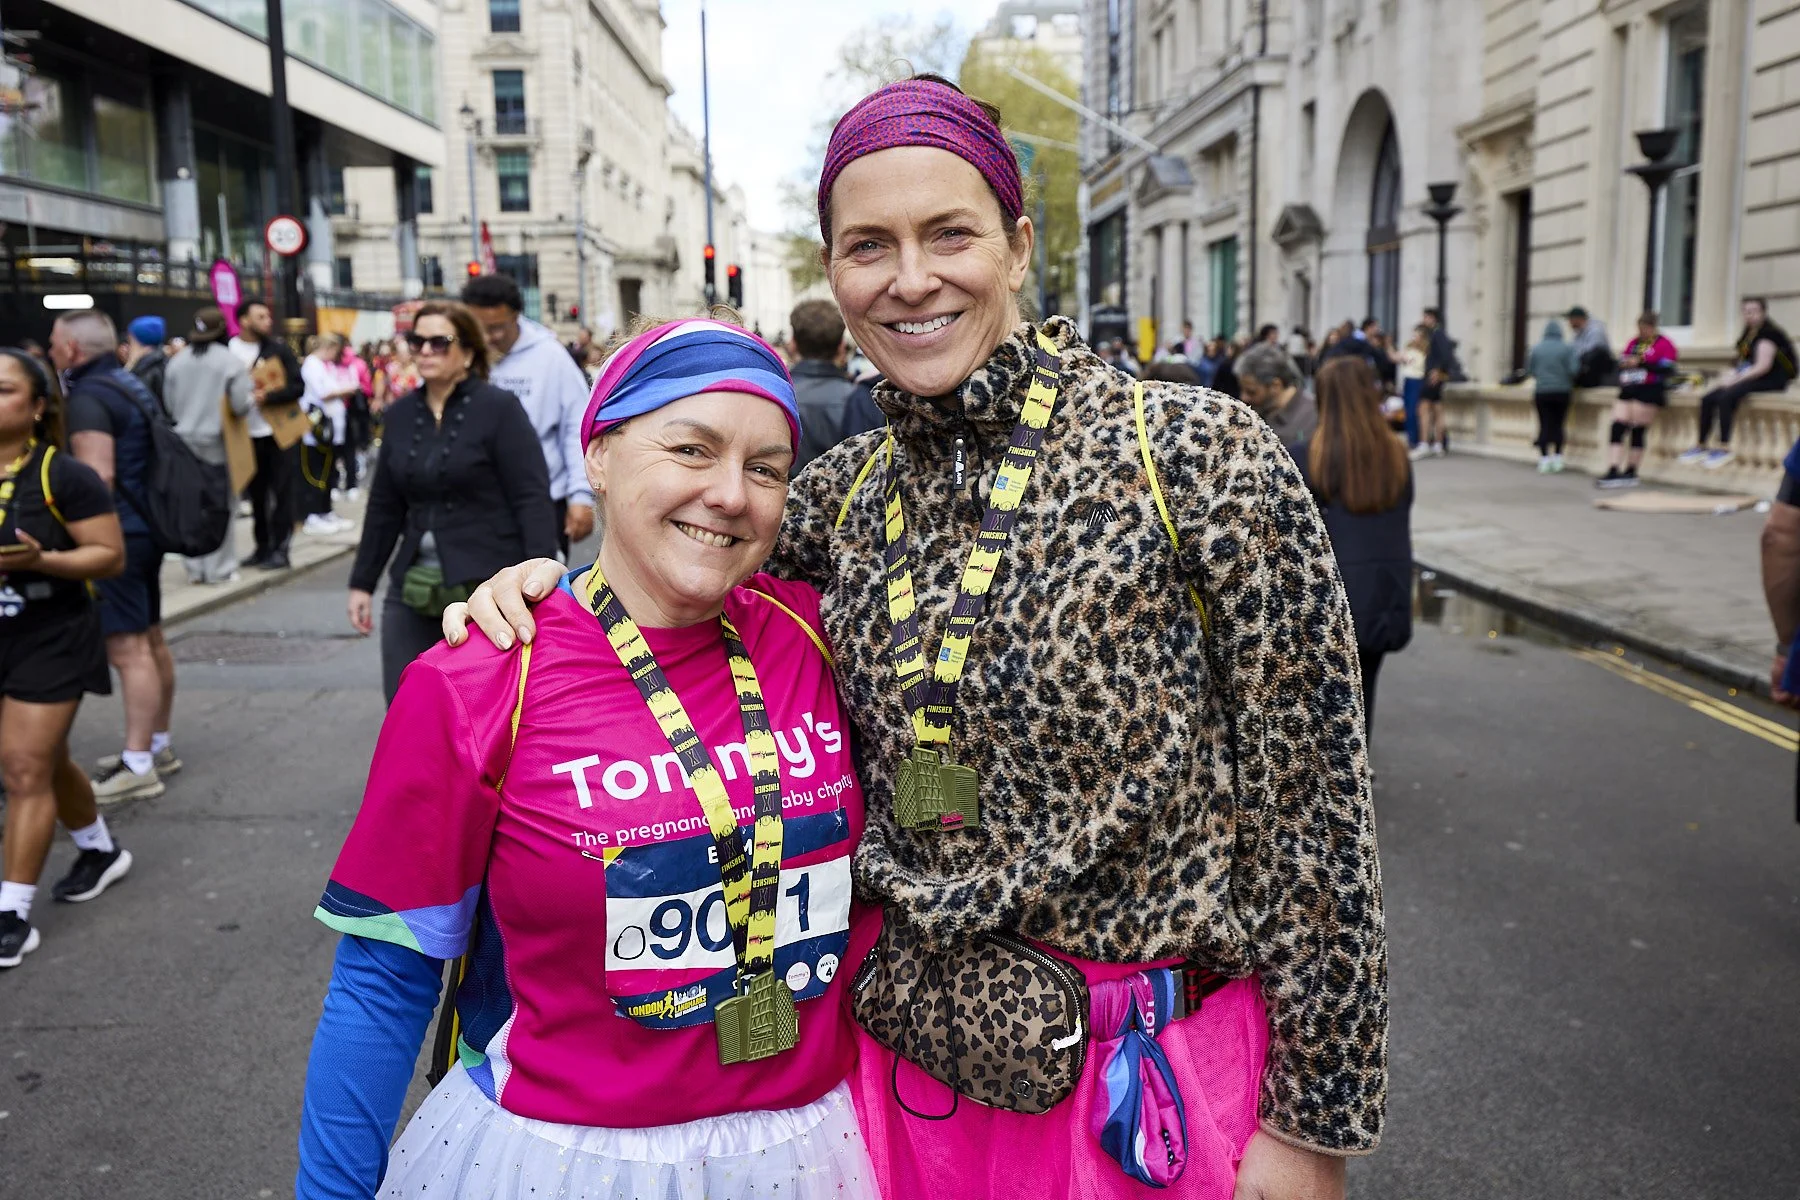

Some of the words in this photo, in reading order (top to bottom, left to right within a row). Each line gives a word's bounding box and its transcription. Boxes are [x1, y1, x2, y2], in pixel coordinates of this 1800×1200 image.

[1036, 365, 1059, 380] FINISHER
[1008, 445, 1036, 458] FINISHER
[979, 530, 1007, 541] FINISHER
[888, 553, 908, 574] FINISHER
[950, 616, 976, 625] FINISHER
[895, 636, 919, 654] FINISHER
[631, 660, 657, 680] FINISHER
[901, 671, 924, 691] FINISHER
[741, 703, 764, 712] FINISHER
[926, 704, 953, 714] FINISHER
[674, 735, 700, 753] FINISHER
[552, 711, 842, 809] Tommy's
[754, 782, 780, 795] FINISHER
[571, 831, 609, 847] The
[615, 815, 709, 846] pregnanc
[781, 790, 814, 809] aby
[721, 853, 746, 874] FINISHER
[752, 875, 778, 888] FINISHER
[649, 872, 810, 960] 901
[820, 959, 836, 968] WAVE
[825, 967, 833, 978] 4
[628, 1000, 664, 1016] LONDON
